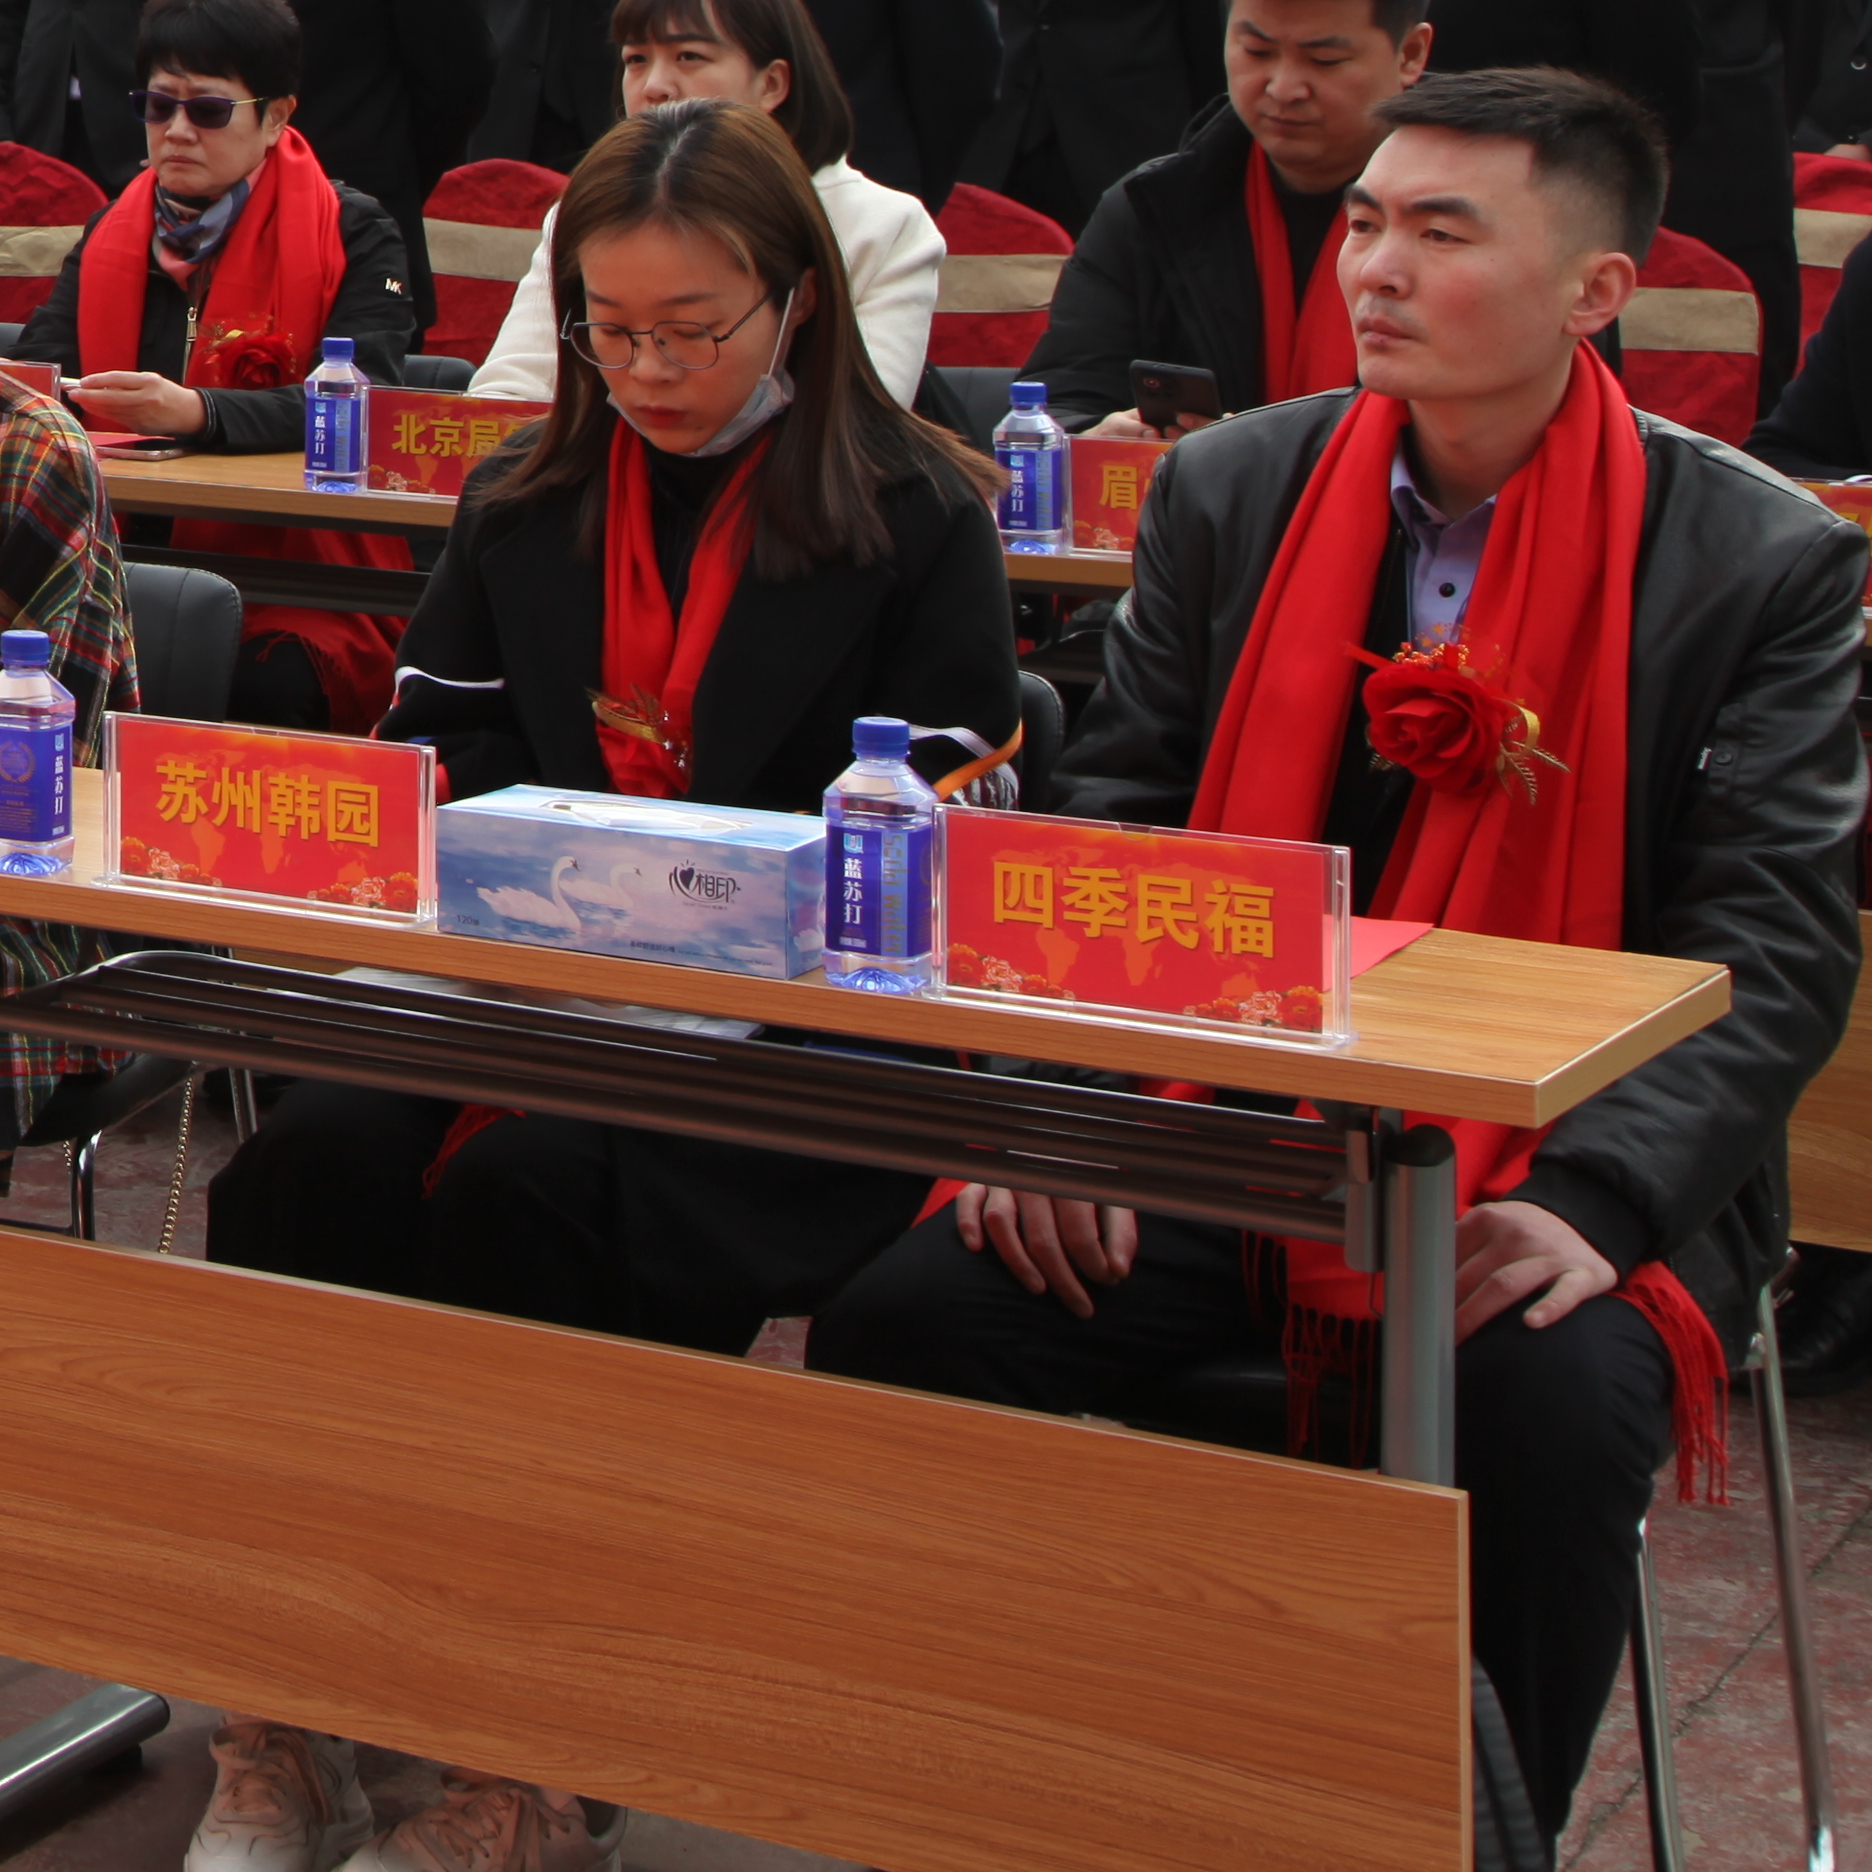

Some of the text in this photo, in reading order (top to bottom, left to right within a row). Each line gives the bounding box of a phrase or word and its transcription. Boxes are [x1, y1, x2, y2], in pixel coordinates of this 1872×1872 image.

[386, 277, 403, 296] MK
[155, 760, 380, 847] 苏州韩园
[843, 856, 864, 925] 蓝苏打
[992, 861, 1275, 959] 四季民福
